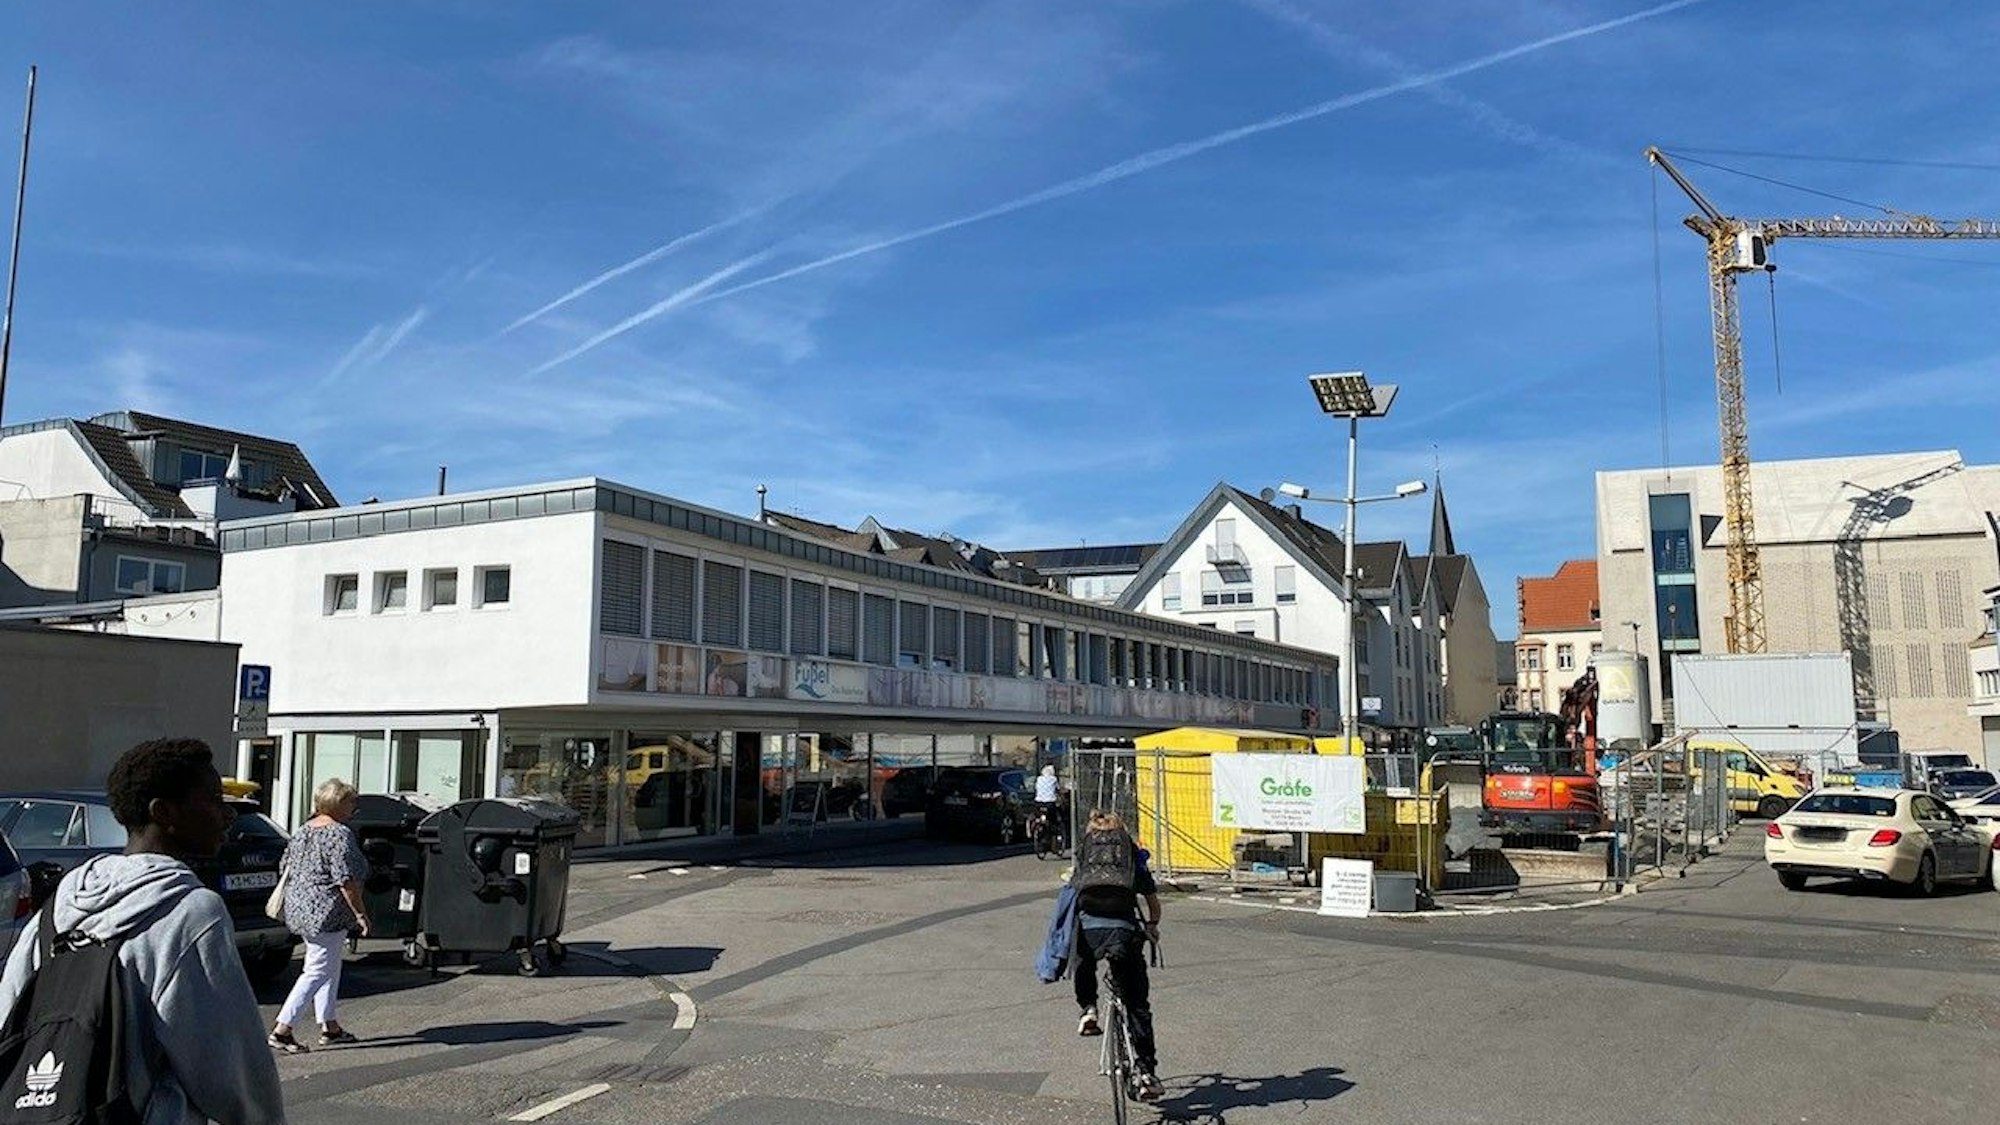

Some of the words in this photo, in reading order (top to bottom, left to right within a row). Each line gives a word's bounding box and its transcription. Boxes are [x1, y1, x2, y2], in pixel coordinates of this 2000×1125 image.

[247, 668, 265, 697] P
[1260, 777, 1312, 797] Gräfe
[15, 1091, 58, 1109] adida
